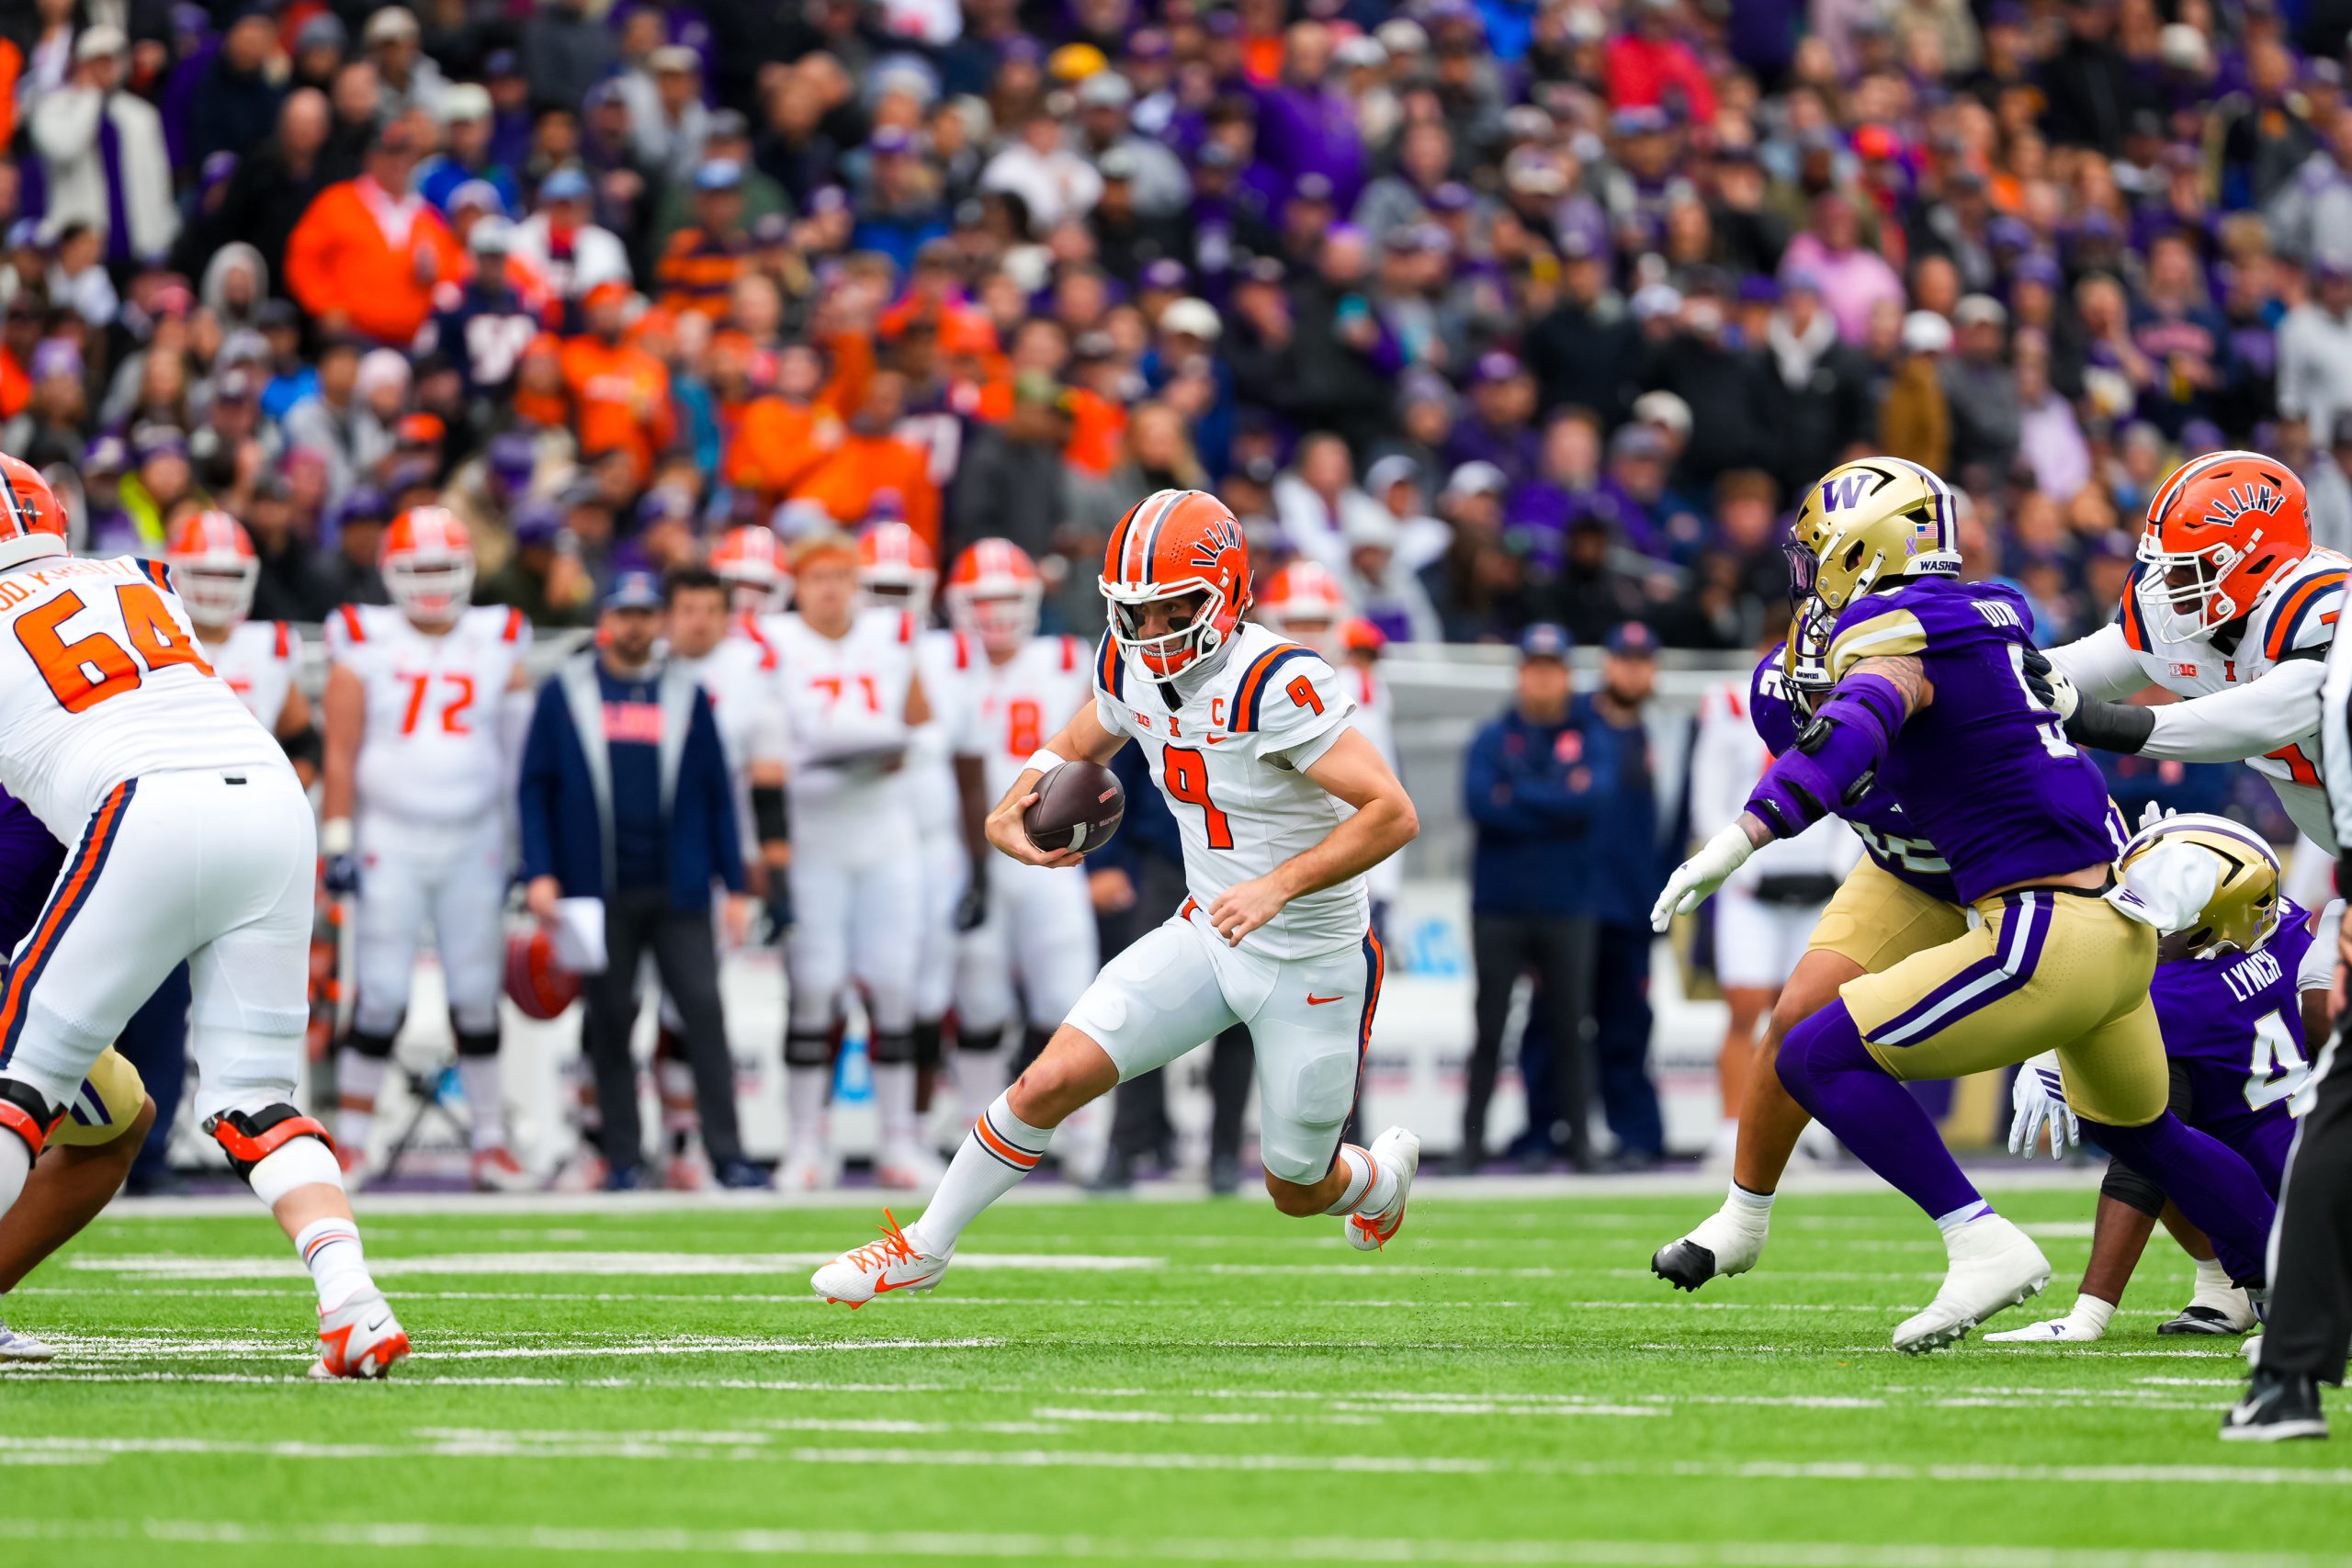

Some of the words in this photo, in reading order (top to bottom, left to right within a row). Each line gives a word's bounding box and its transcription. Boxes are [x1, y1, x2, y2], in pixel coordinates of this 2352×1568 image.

[1822, 474, 1872, 513] W
[2204, 483, 2286, 527] ILLINI
[1190, 521, 1242, 567] ILLINI
[13, 583, 217, 714] 64
[2223, 660, 2236, 682] I
[394, 672, 475, 735] 72
[1212, 698, 1225, 726] C
[1286, 675, 1325, 716] 9
[1169, 716, 1182, 738] I
[1162, 742, 1234, 850] 9
[2221, 949, 2283, 1002] LYNCH
[2242, 1009, 2315, 1119] 4
